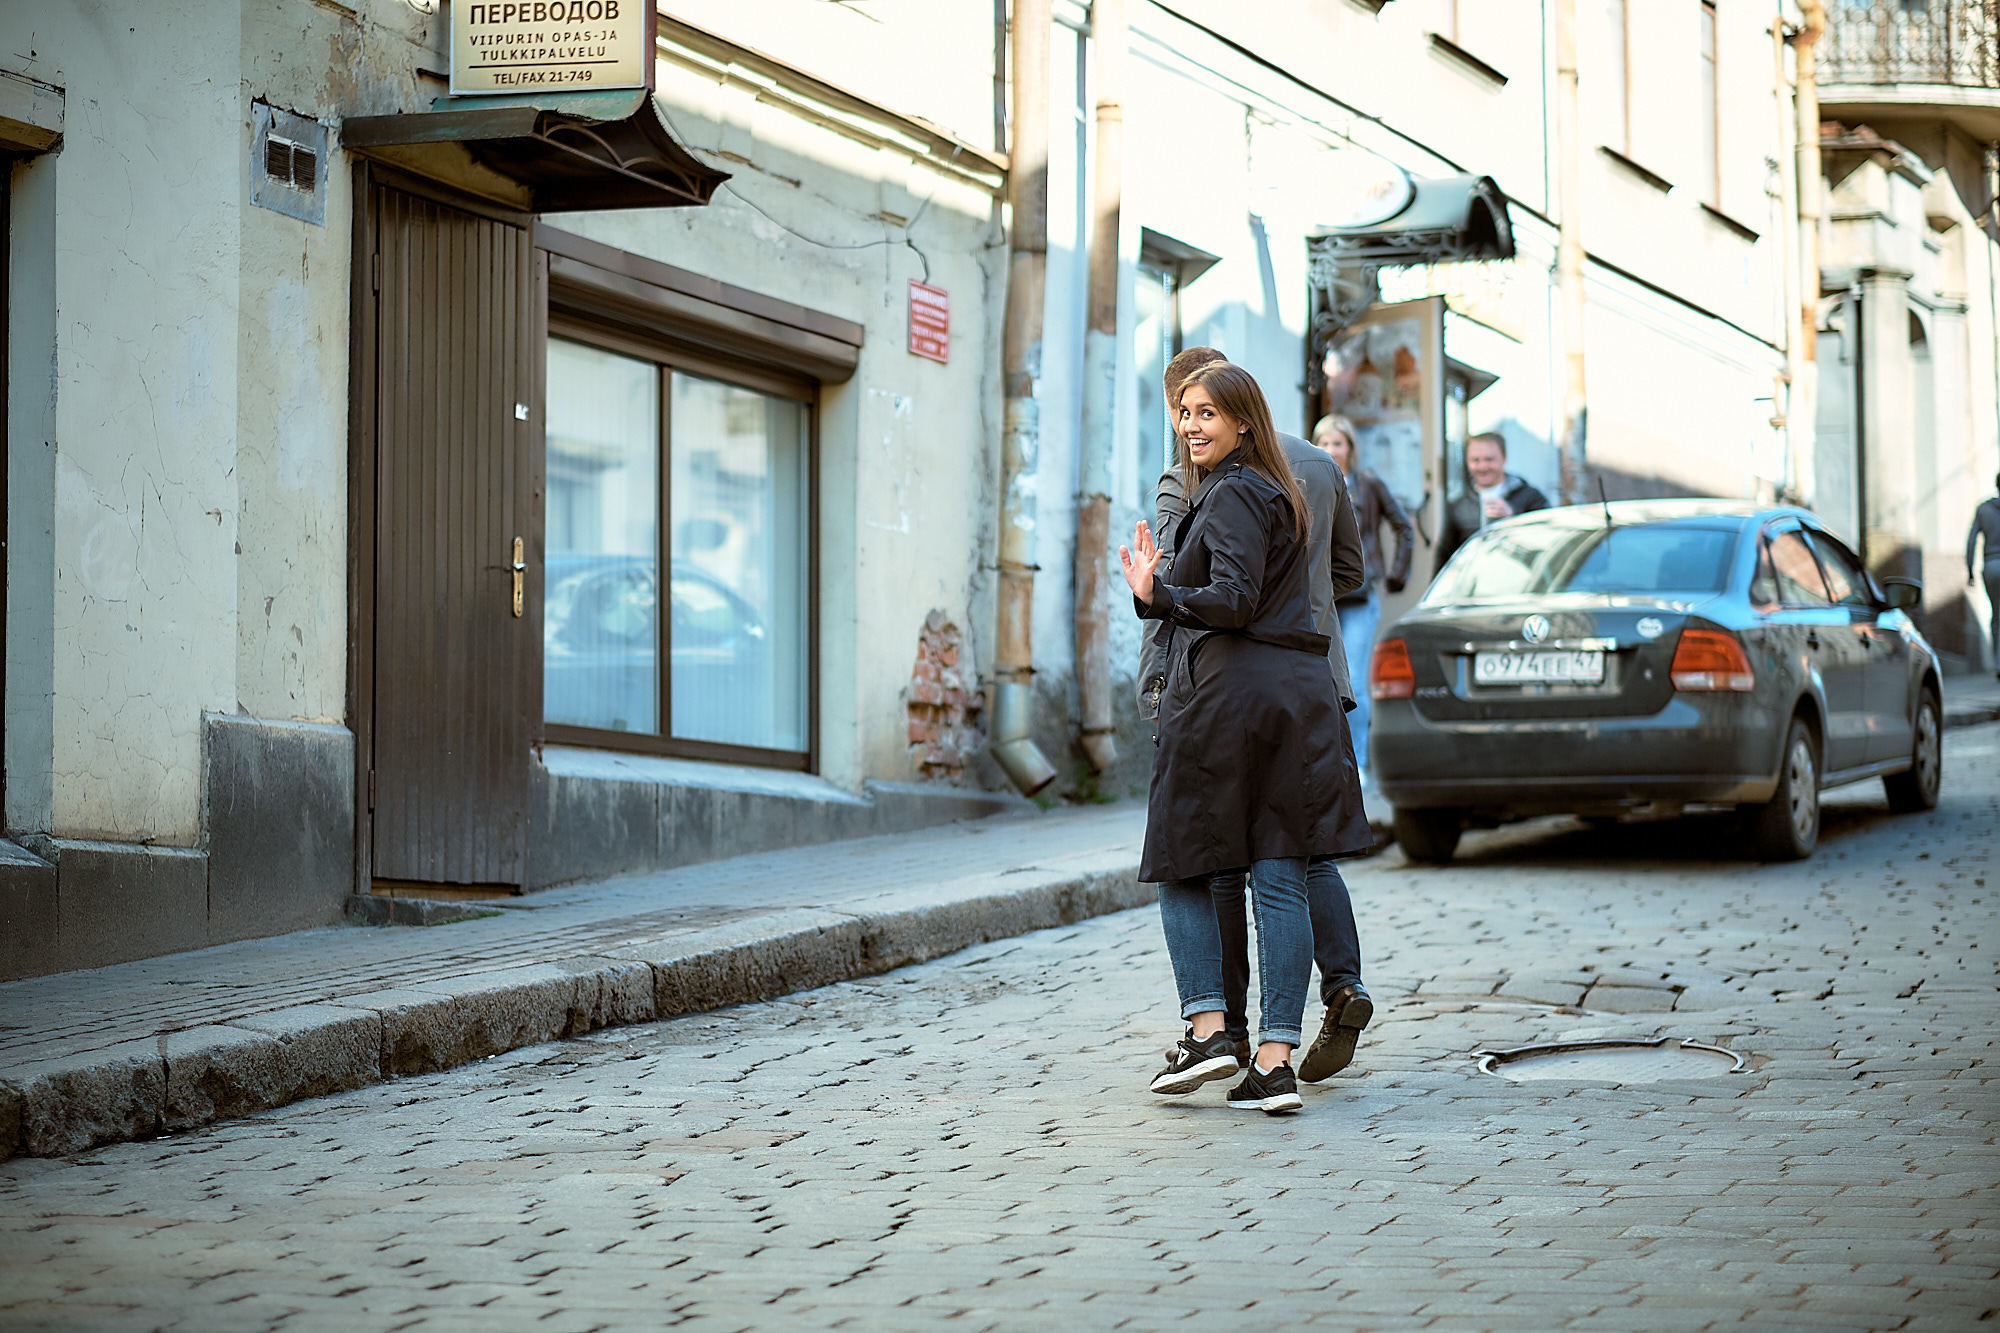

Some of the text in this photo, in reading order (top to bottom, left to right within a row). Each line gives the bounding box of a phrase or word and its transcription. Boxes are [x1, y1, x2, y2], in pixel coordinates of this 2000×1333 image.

[470, 0, 619, 25] ПЕРЕВОДОВ
[469, 33, 545, 46] VIIPURIN
[479, 46, 606, 62] TULKKIPALVELU
[492, 70, 593, 86] TEL/FAX 21-749
